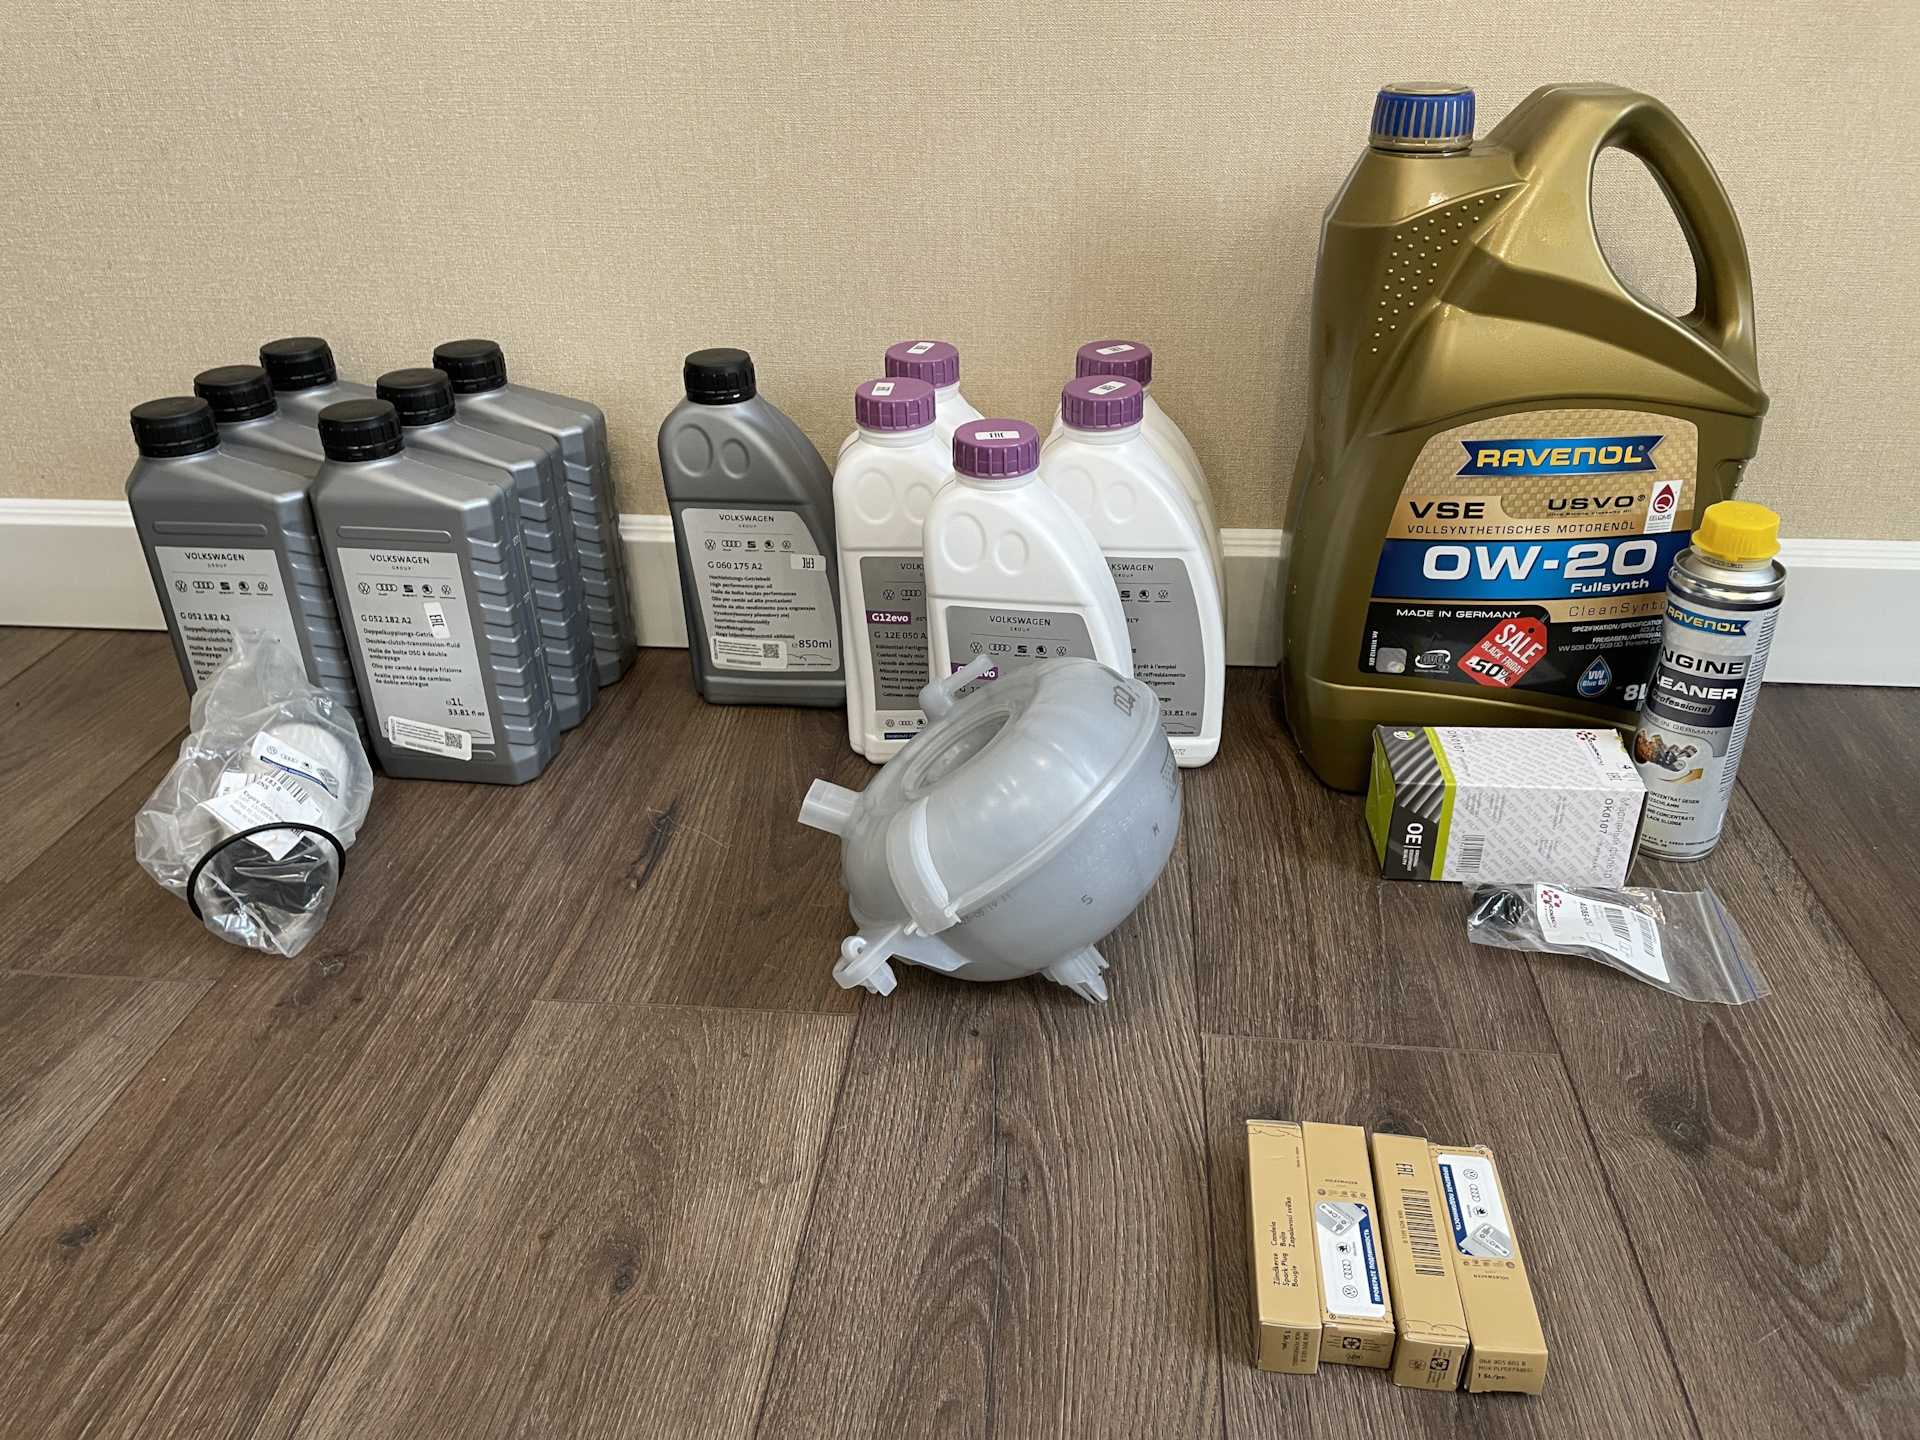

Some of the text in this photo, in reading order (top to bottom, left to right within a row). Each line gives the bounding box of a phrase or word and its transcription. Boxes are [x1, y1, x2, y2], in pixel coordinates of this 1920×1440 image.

[1476, 446, 1643, 467] RAVENOL
[1409, 501, 1485, 519] VSE
[1548, 495, 1635, 510] USVO
[719, 514, 774, 522] VOLKSWAGEN
[1407, 525, 1550, 535] VOLLSYNTHETISCHES
[1556, 520, 1636, 534] MOTORENÖL
[185, 552, 245, 561] VOLKSWAGEN
[370, 554, 430, 564] VOLKSWAGEN
[1422, 540, 1658, 580] 0W-20
[1570, 579, 1650, 593] Fullsynth
[872, 613, 909, 622] G12evo
[989, 616, 1051, 626] VOLKSWAGEN
[1396, 609, 1434, 617] MADE
[1456, 610, 1521, 619] GERMANY
[1668, 605, 1740, 632] RAVENOL
[1494, 624, 1543, 664] SALE
[1481, 640, 1525, 675] BLACK FRIDAY
[1662, 645, 1745, 675] NGINE
[1588, 670, 1605, 679] VW
[1653, 690, 1712, 713] Professional
[1673, 724, 1720, 736] GERMANY
[1599, 798, 1614, 834] OK0107
[1656, 810, 1695, 820] CONCENTRATE
[1406, 823, 1424, 844] OE
[1269, 1221, 1281, 1286] Zündkerze Candela
[1282, 1268, 1290, 1286] Spark
[1291, 1265, 1299, 1287] Bougie
